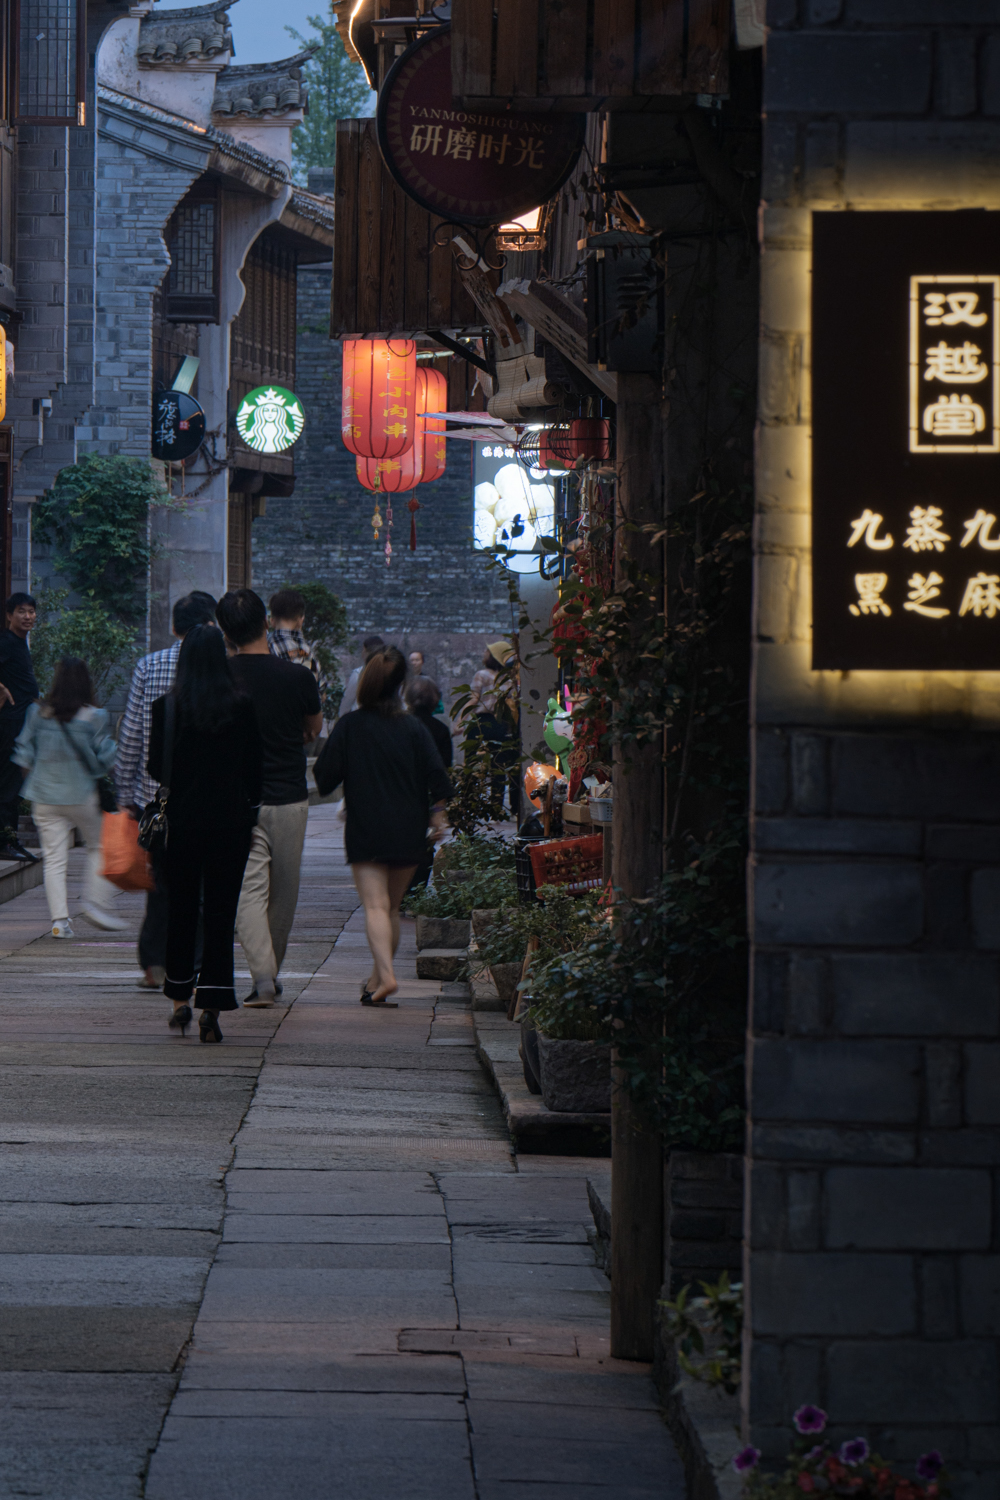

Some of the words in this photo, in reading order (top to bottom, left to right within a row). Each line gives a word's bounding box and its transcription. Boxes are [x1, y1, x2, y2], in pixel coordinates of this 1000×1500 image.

[409, 105, 554, 136] YANMOSHIGUANG
[409, 123, 546, 170] 研磨时光
[923, 290, 989, 438] 汉越堂
[846, 505, 1000, 553] 九蒸九
[847, 571, 1000, 619] 黑芝麻
